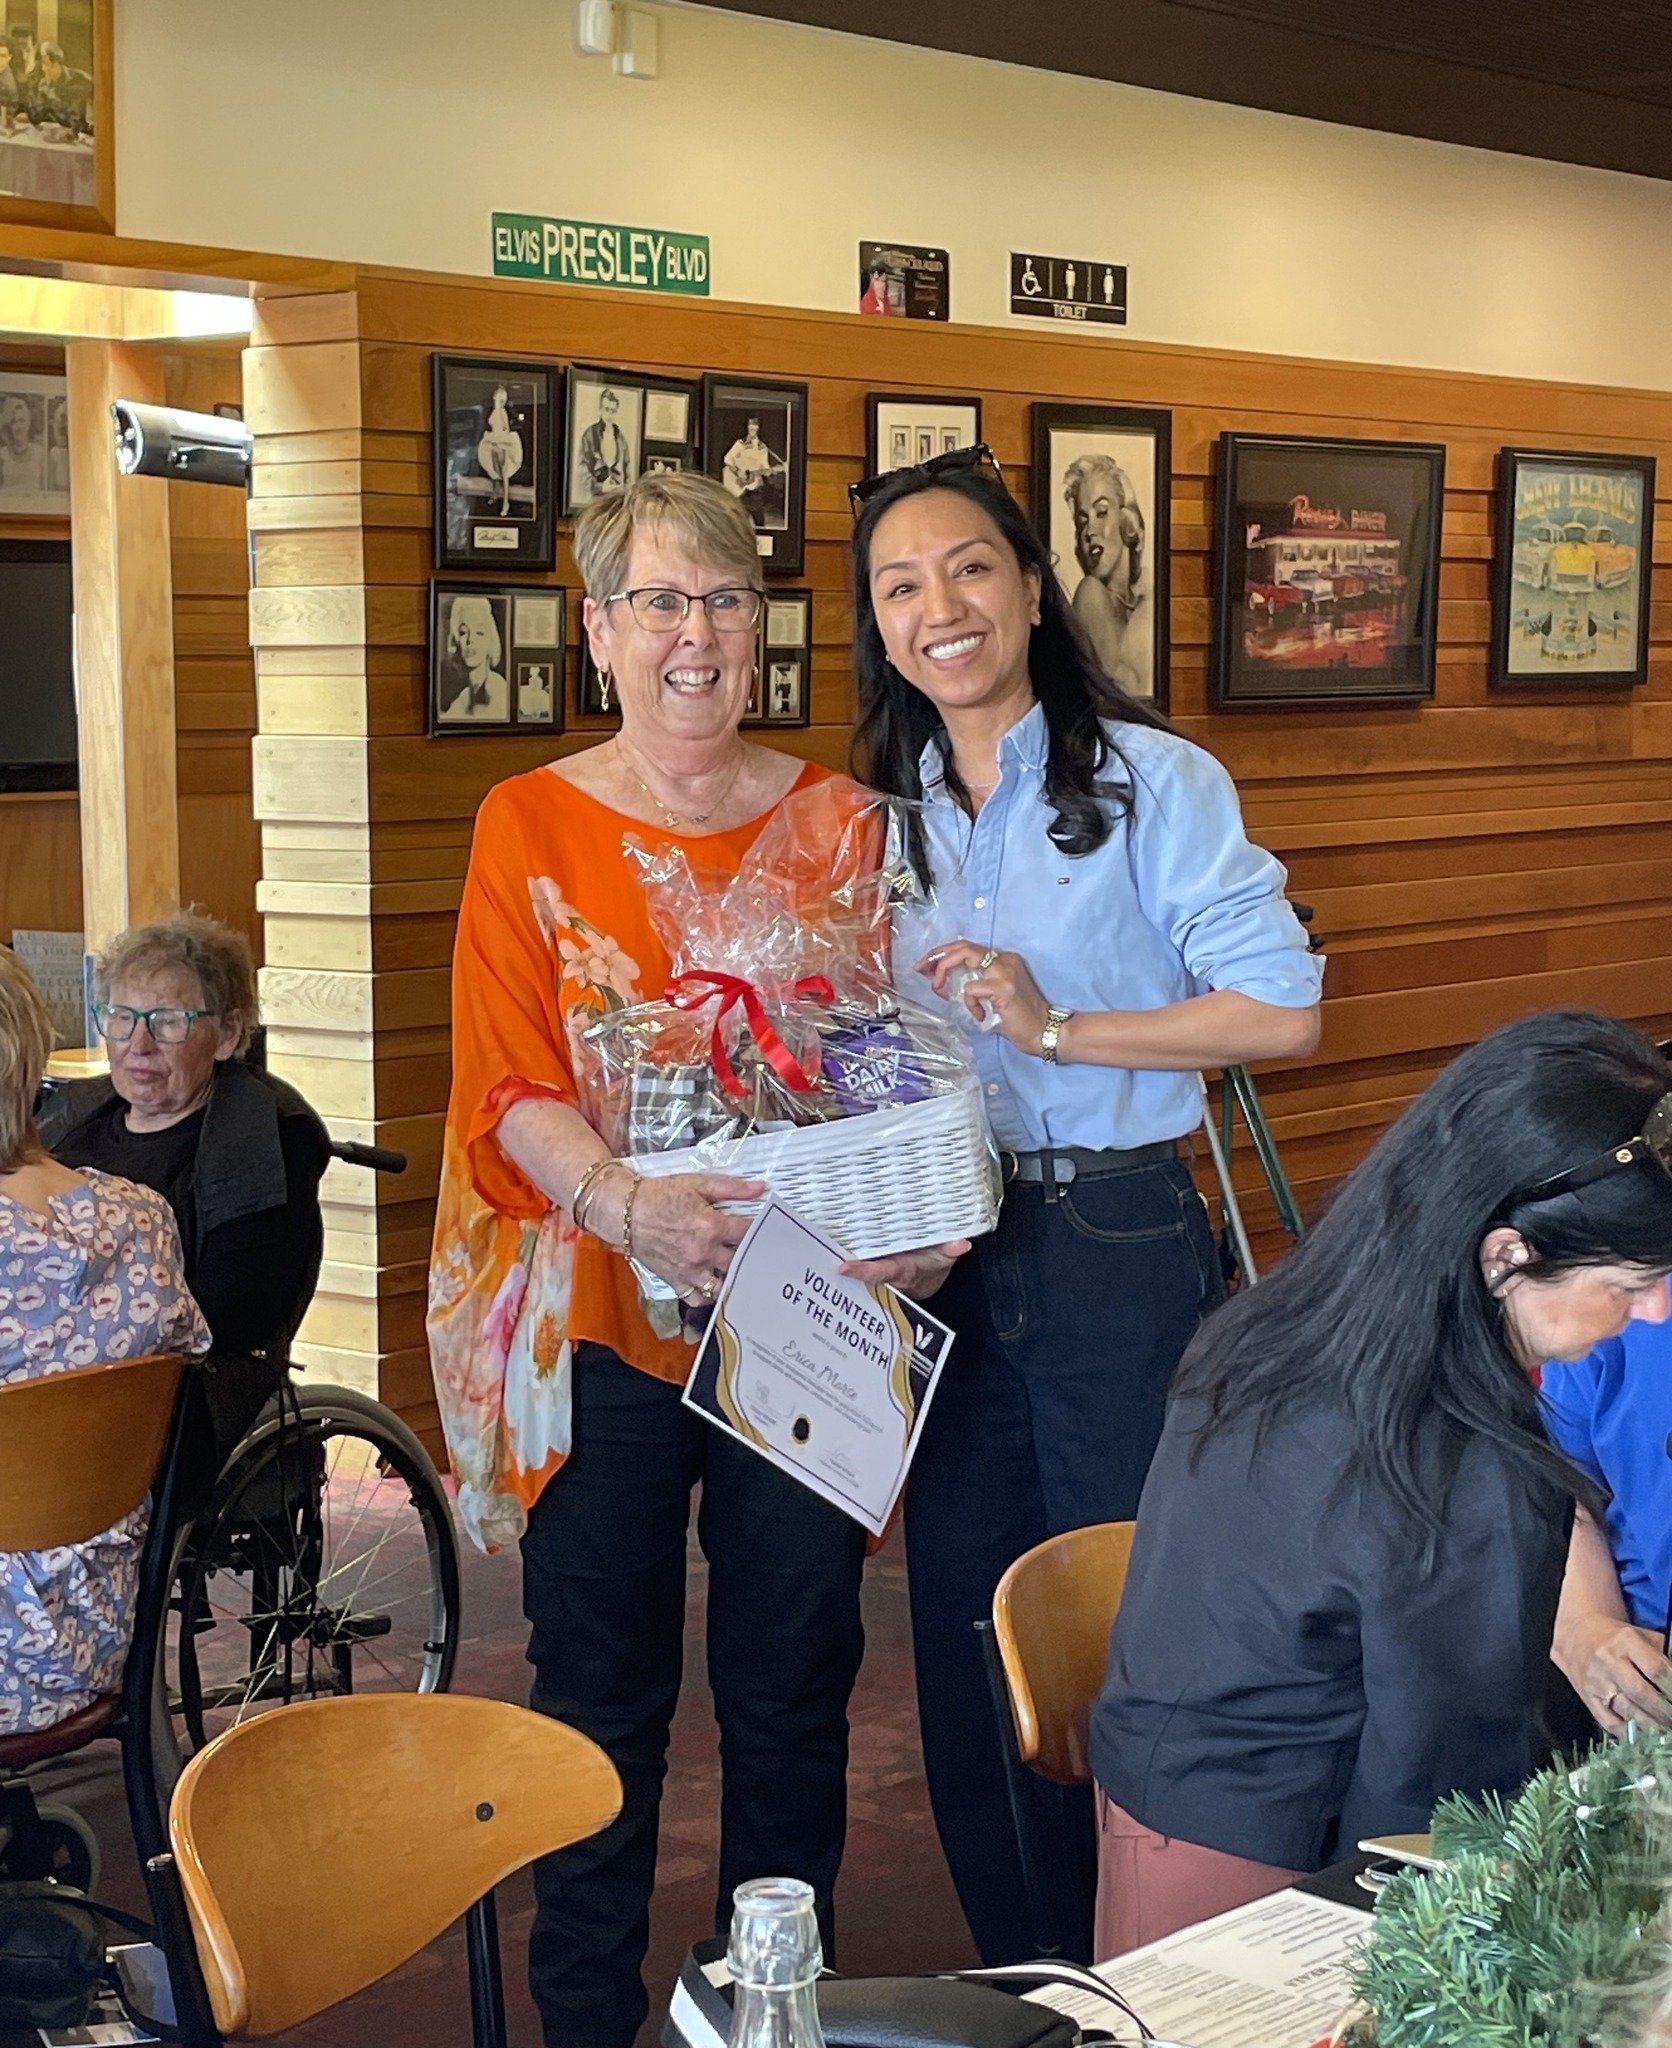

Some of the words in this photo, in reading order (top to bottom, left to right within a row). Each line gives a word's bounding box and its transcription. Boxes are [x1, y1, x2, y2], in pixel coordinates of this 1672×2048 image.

[495, 227, 540, 264] ELVIS
[543, 223, 665, 286] PRESLEY
[666, 245, 707, 282] BLVD
[1053, 303, 1088, 319] TOILET
[844, 1053, 900, 1092] DAIRY
[859, 1070, 906, 1098] MILK
[804, 1267, 886, 1340] VOLUNTEER
[782, 1283, 803, 1305] OF
[805, 1298, 834, 1328] THE
[834, 1321, 890, 1370] MONTH
[781, 1340, 816, 1373] Erica
